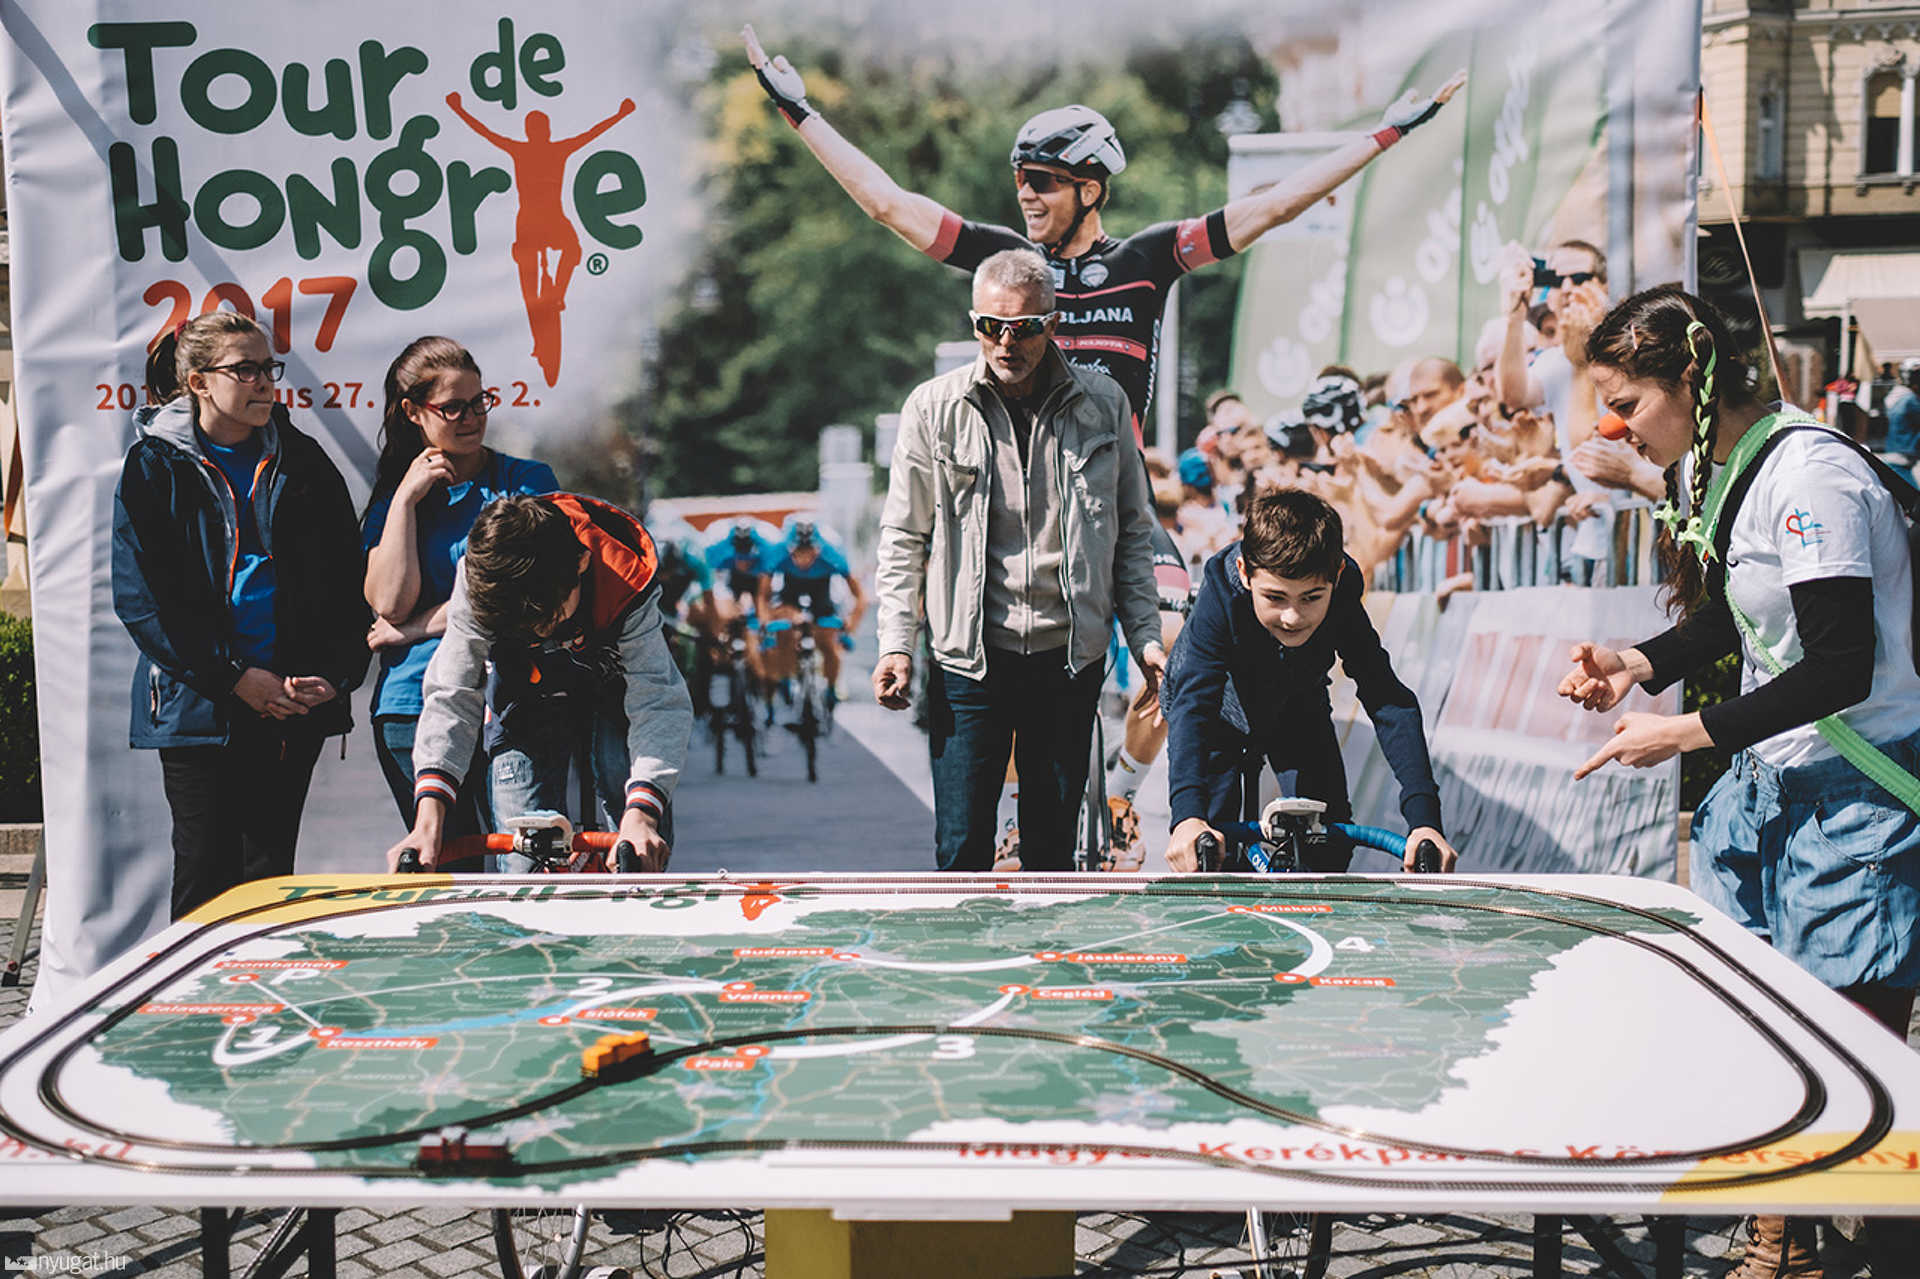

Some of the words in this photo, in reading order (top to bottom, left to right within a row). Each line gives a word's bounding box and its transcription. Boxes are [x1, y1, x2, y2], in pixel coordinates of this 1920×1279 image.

[87, 20, 430, 141] Tour
[469, 17, 566, 111] de
[1059, 306, 1134, 325] BLJANA
[95, 383, 152, 411] 201
[322, 382, 375, 410] 27.
[511, 381, 542, 408] 2.
[1335, 936, 1376, 952] 4
[739, 948, 826, 957] Budapest
[1075, 953, 1180, 962] Jászberény
[221, 960, 341, 969] Szombathely
[269, 968, 321, 985] P
[1319, 978, 1386, 986] Karcag
[568, 977, 615, 997] 2
[1039, 989, 1105, 998] Cegléd
[726, 993, 805, 1001] Velence
[146, 1004, 277, 1014] Zalaegerszeg
[585, 1008, 649, 1018] Siófok
[233, 1026, 282, 1049] 1
[326, 1038, 431, 1049] Keszthely
[933, 1035, 976, 1060] 3
[694, 1059, 744, 1069] Paks
[1198, 1142, 1541, 1166] Kerékpárs
